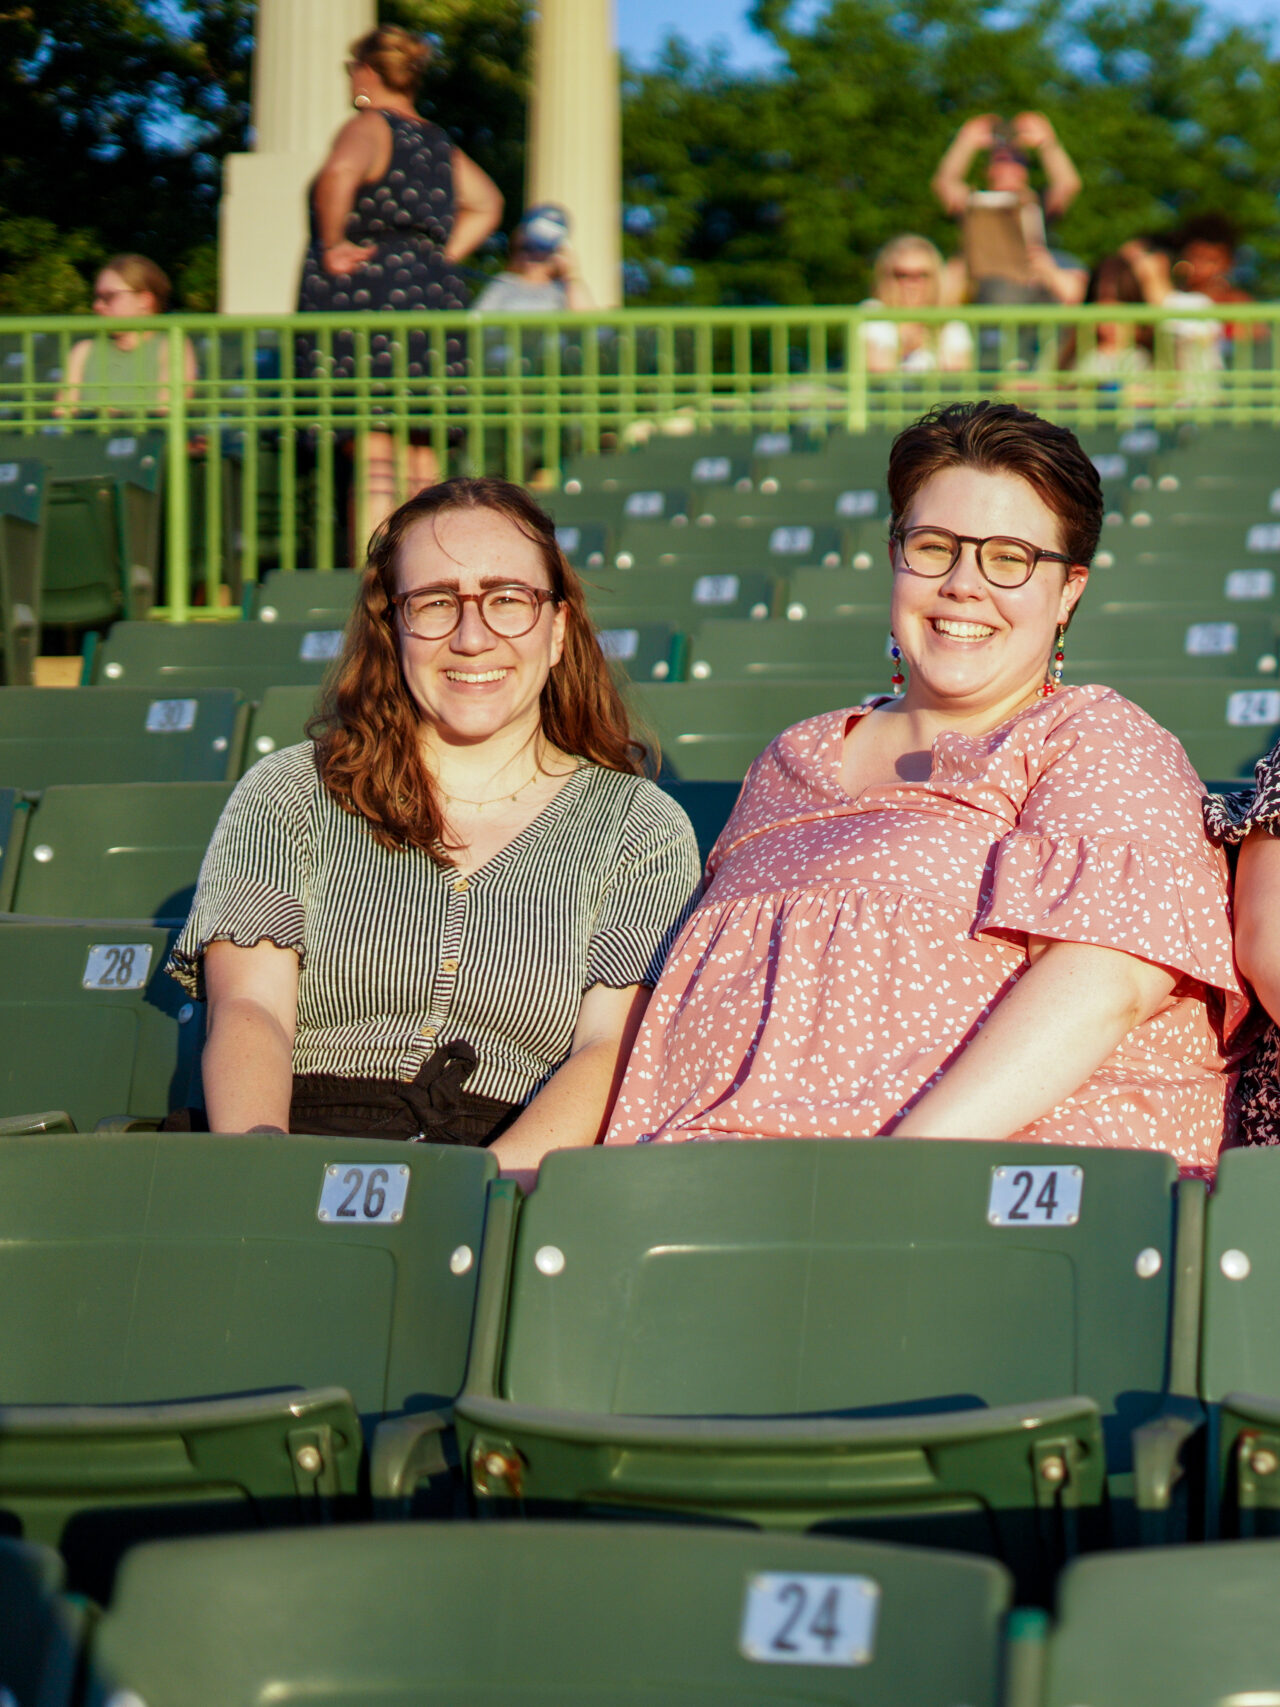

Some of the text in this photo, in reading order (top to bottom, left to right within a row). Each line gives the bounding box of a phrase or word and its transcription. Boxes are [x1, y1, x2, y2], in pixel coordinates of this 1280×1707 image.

[1239, 694, 1267, 721] 24
[99, 948, 136, 986] 28
[336, 1168, 389, 1218] 26
[1008, 1171, 1058, 1220] 24
[768, 1582, 840, 1654] 24
